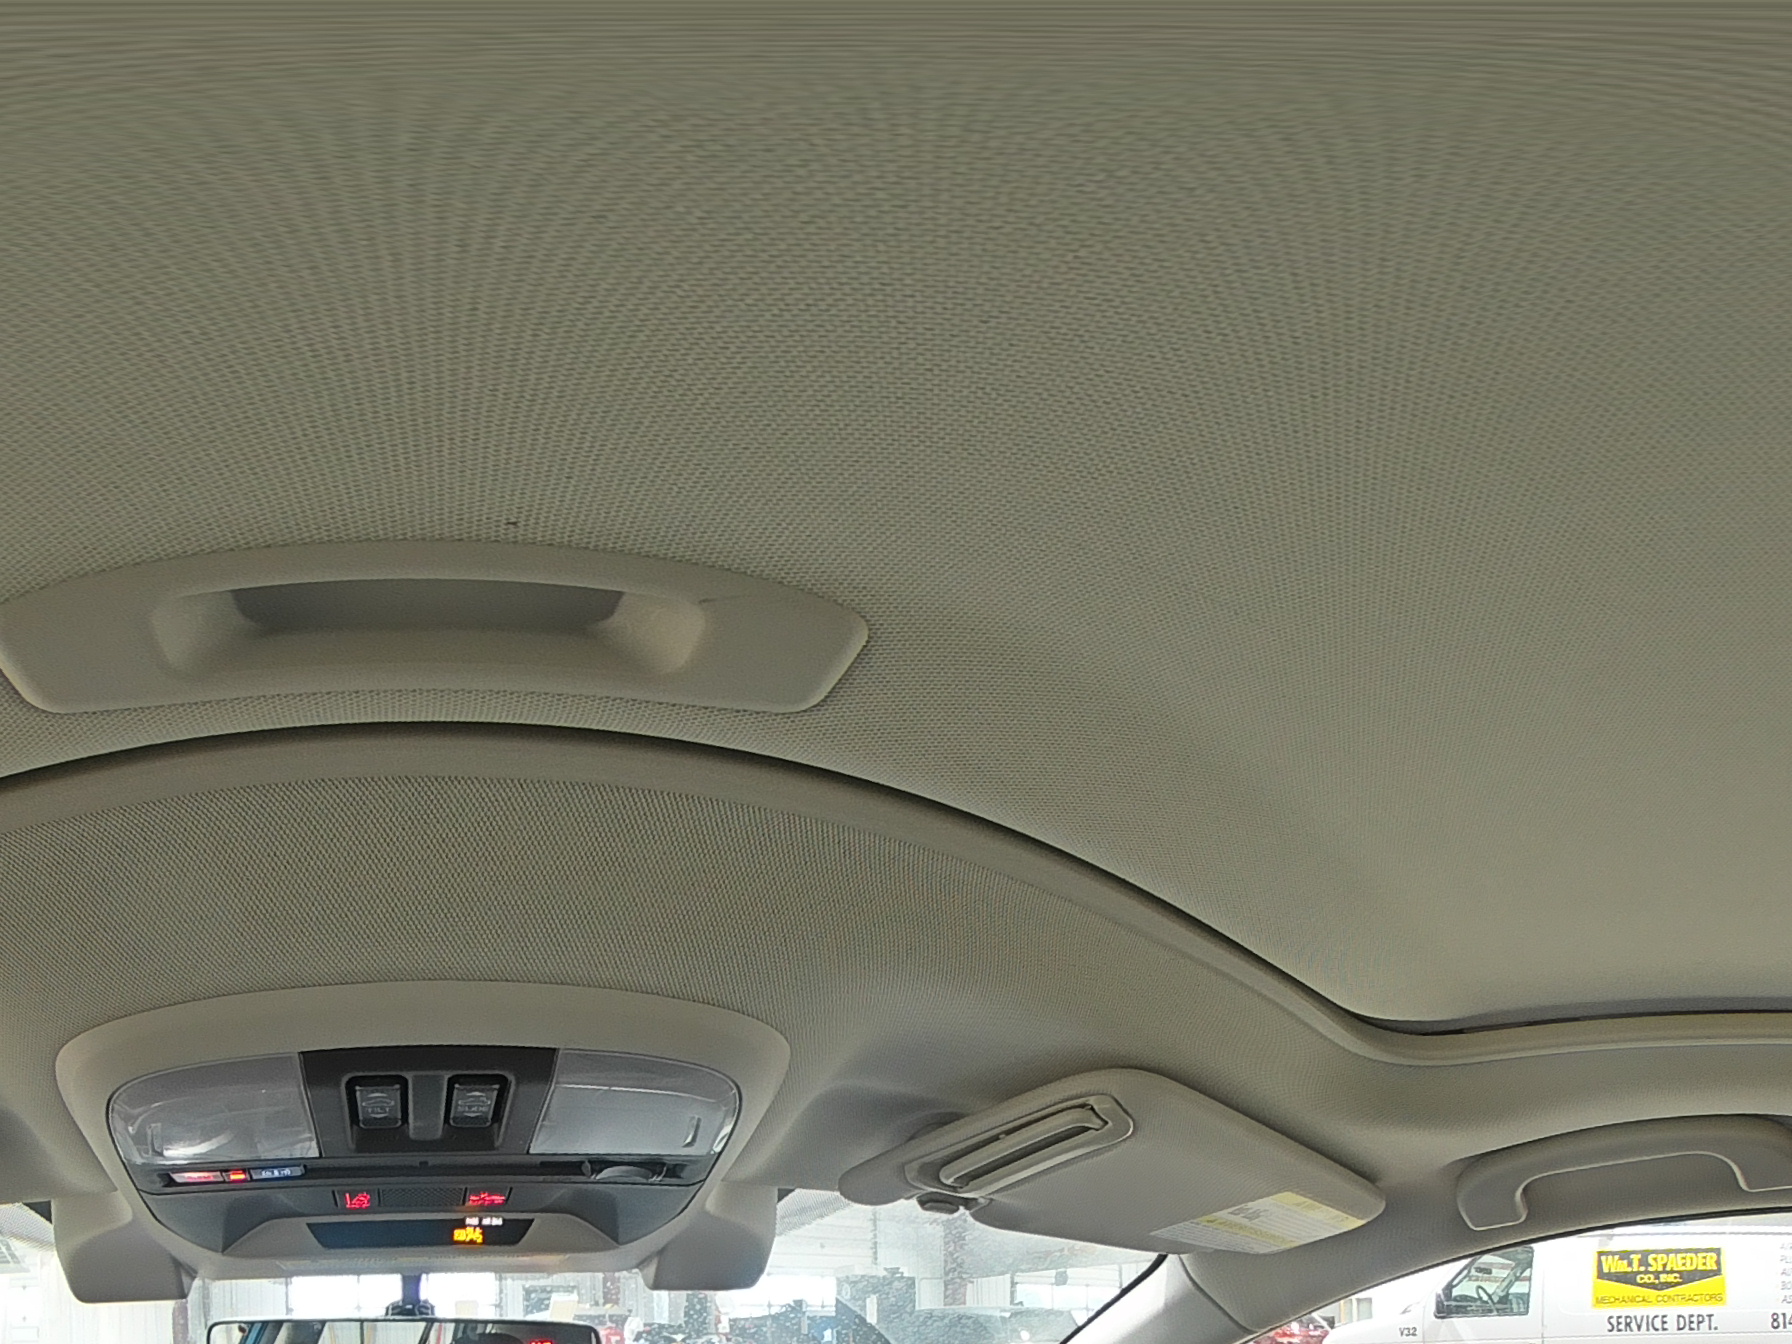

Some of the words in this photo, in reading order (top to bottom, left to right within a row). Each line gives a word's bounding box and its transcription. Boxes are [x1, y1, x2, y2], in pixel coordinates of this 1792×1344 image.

[1648, 1252, 1718, 1272] SPAEDER
[1596, 1295, 1653, 1304] MECHANICAL
[1655, 1293, 1724, 1303] CONTRACTORS
[1606, 1314, 1669, 1332] SERVICE
[1676, 1313, 1719, 1331] DEPT.
[1398, 1326, 1418, 1337] V32
